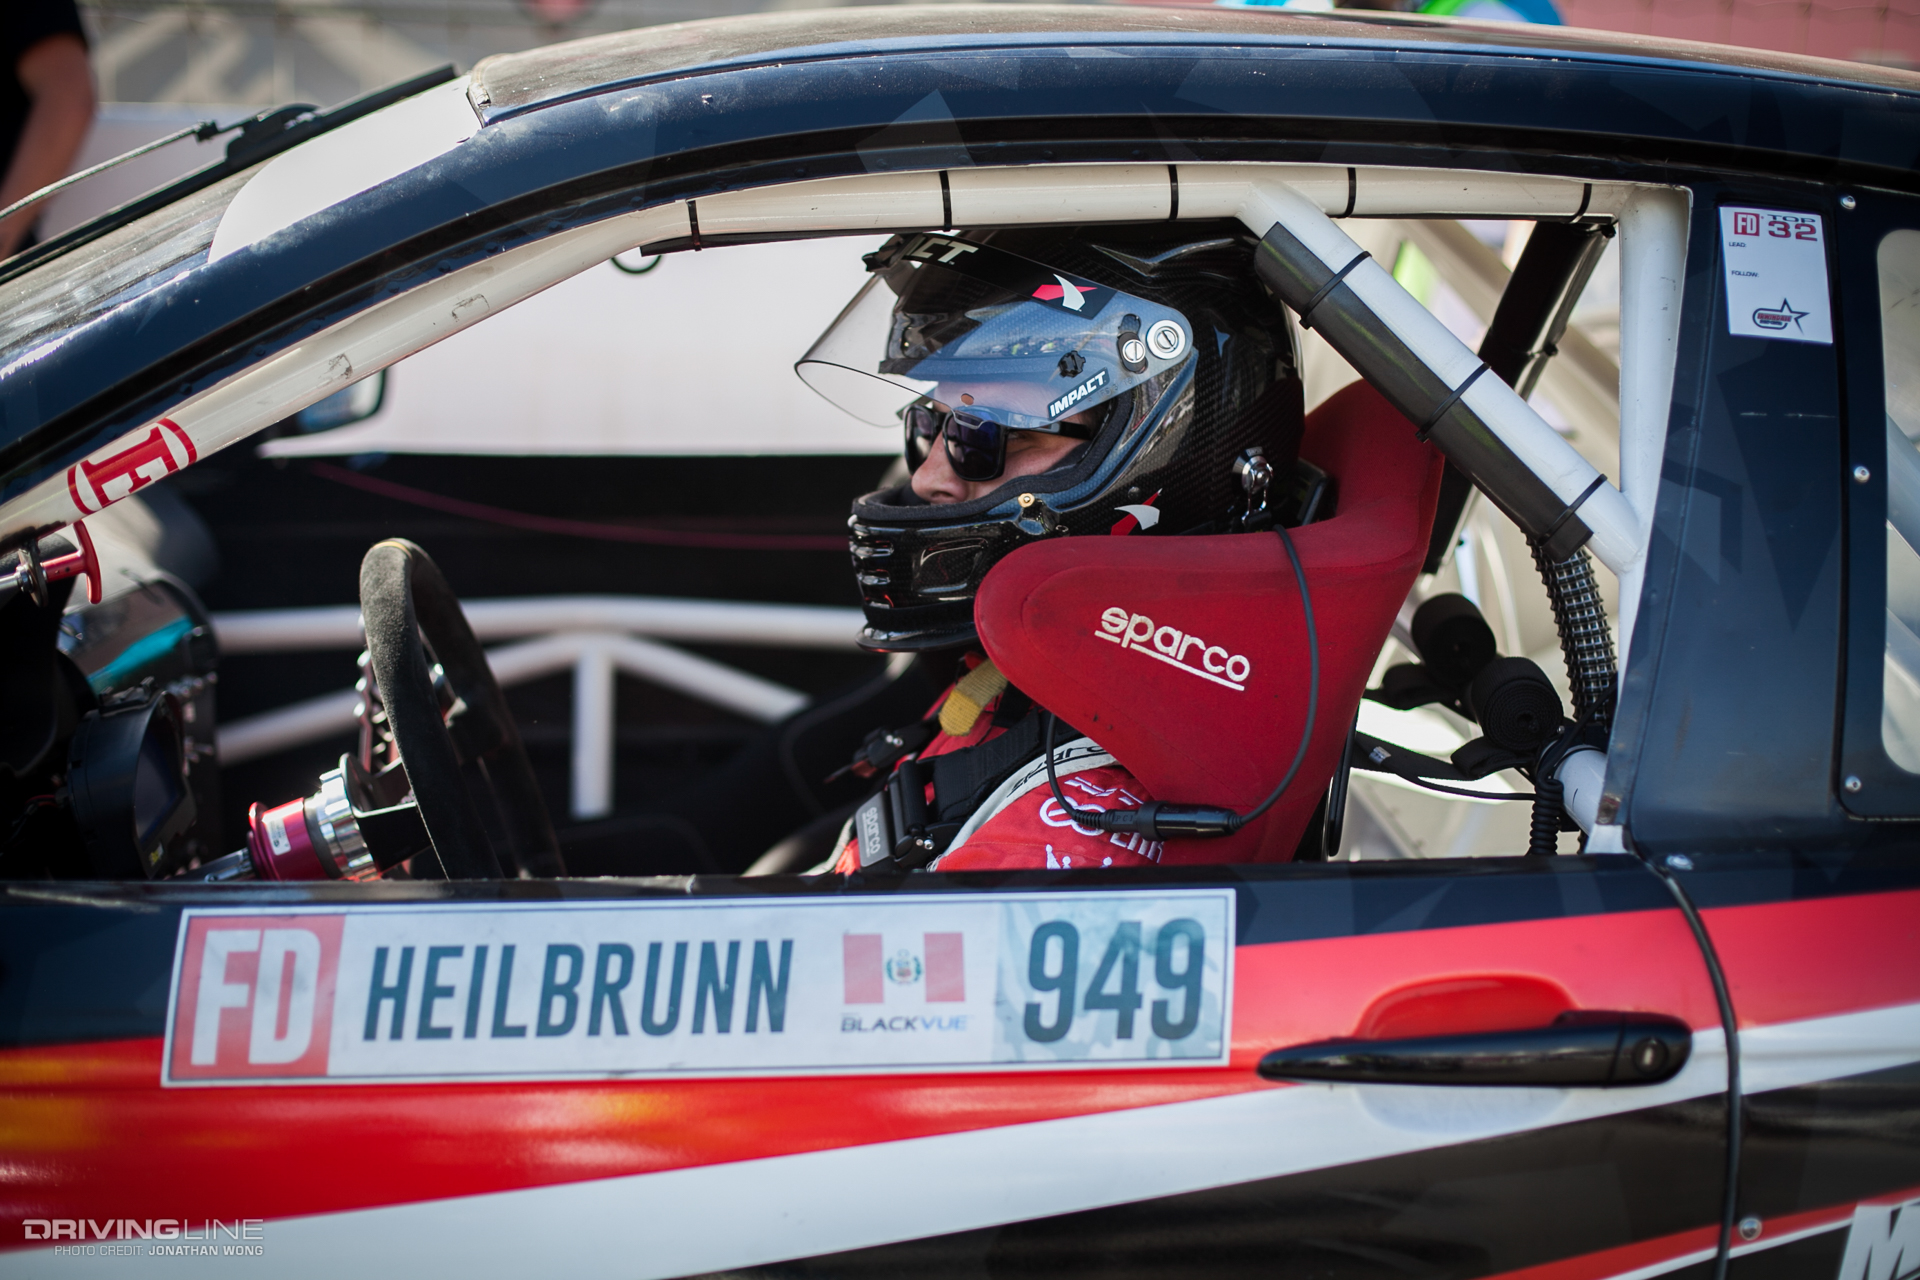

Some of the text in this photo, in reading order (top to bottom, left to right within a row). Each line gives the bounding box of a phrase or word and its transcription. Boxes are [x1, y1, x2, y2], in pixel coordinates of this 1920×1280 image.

[1737, 213, 1758, 235] FD
[1767, 214, 1816, 222] TOP
[1768, 221, 1818, 241] 32
[1731, 270, 1760, 278] FOLLOW:
[1050, 370, 1106, 417] IMPACT
[1101, 606, 1250, 682] sparco
[866, 806, 881, 854] sparco
[191, 928, 322, 1066] FD
[363, 938, 794, 1041] HEILBRUNN
[1022, 918, 1206, 1043] 949
[841, 1015, 968, 1033] BLACKVUE
